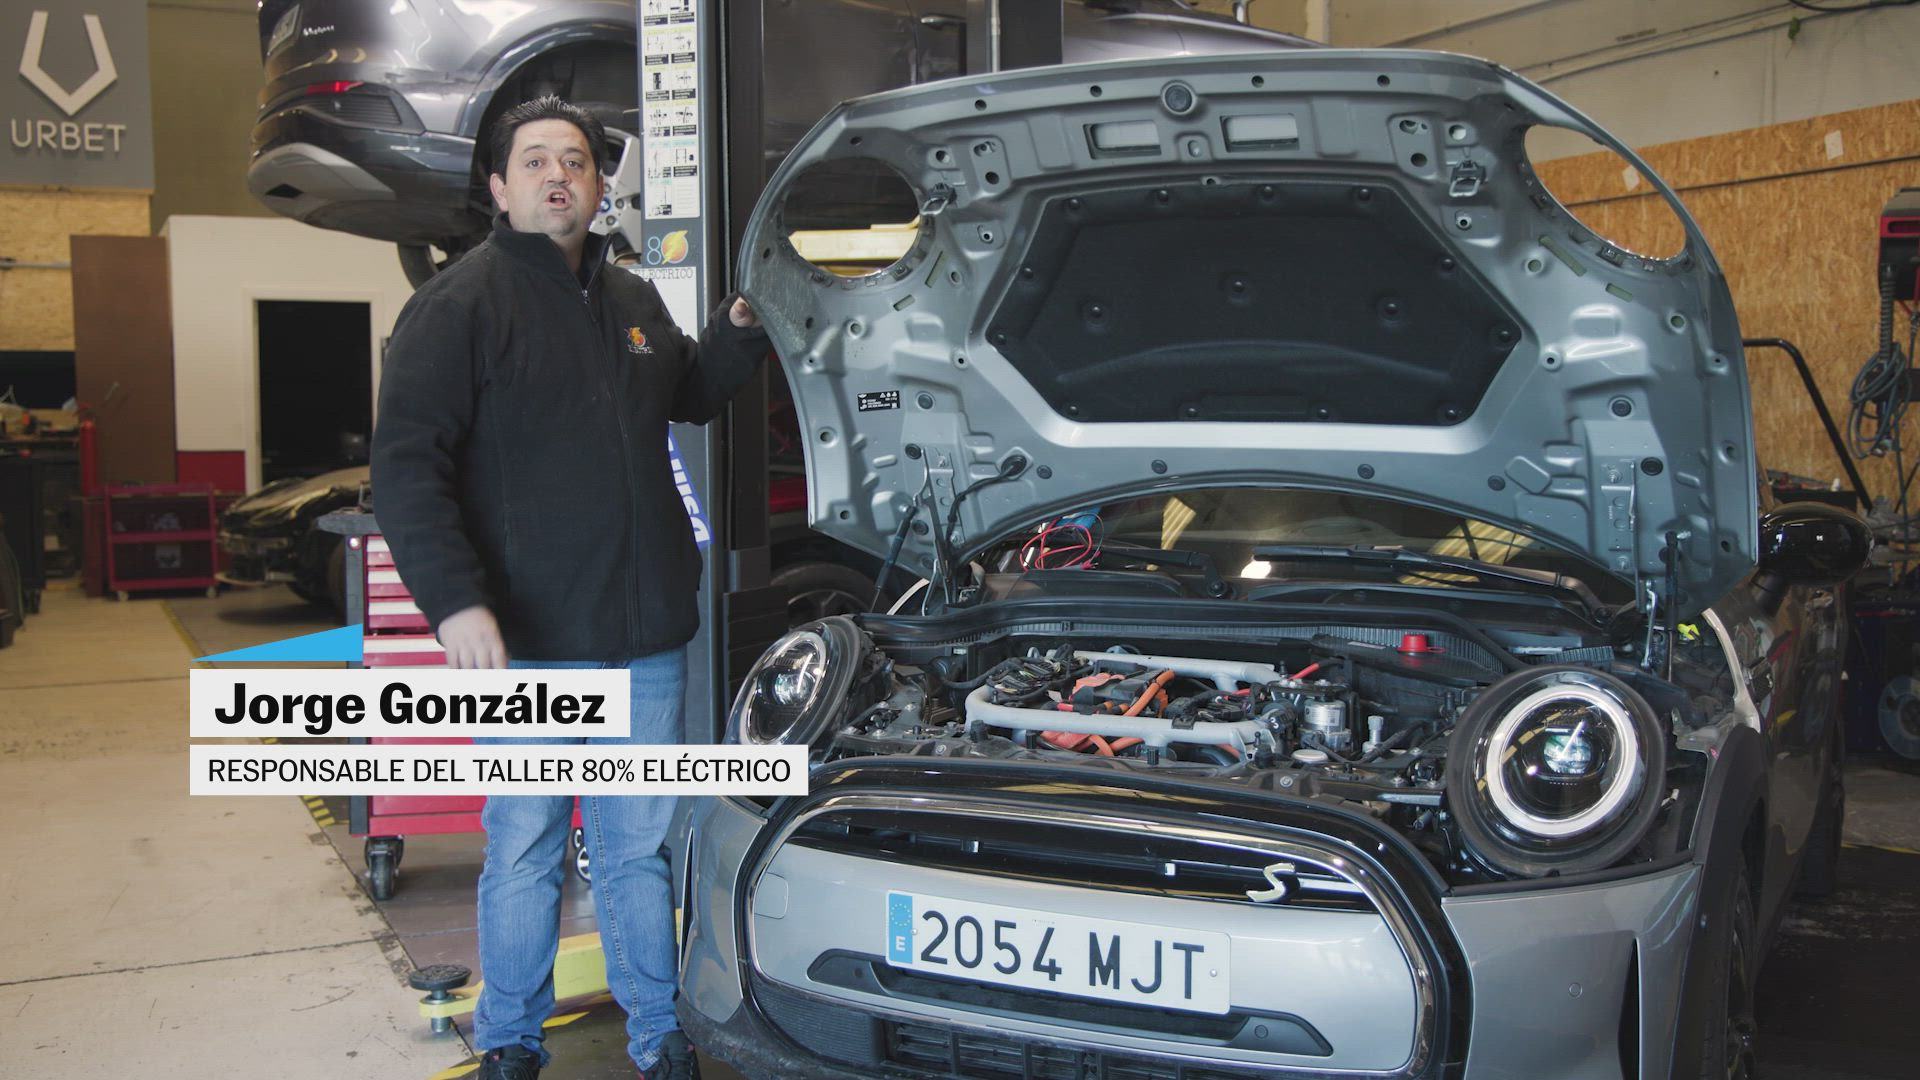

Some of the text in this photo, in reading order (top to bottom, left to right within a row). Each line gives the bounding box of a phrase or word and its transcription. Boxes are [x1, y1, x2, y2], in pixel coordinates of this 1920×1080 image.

[11, 119, 126, 152] URBET
[1246, 863, 1295, 902] S
[895, 935, 906, 952] E
[920, 910, 1205, 1000] 2054 MJT
